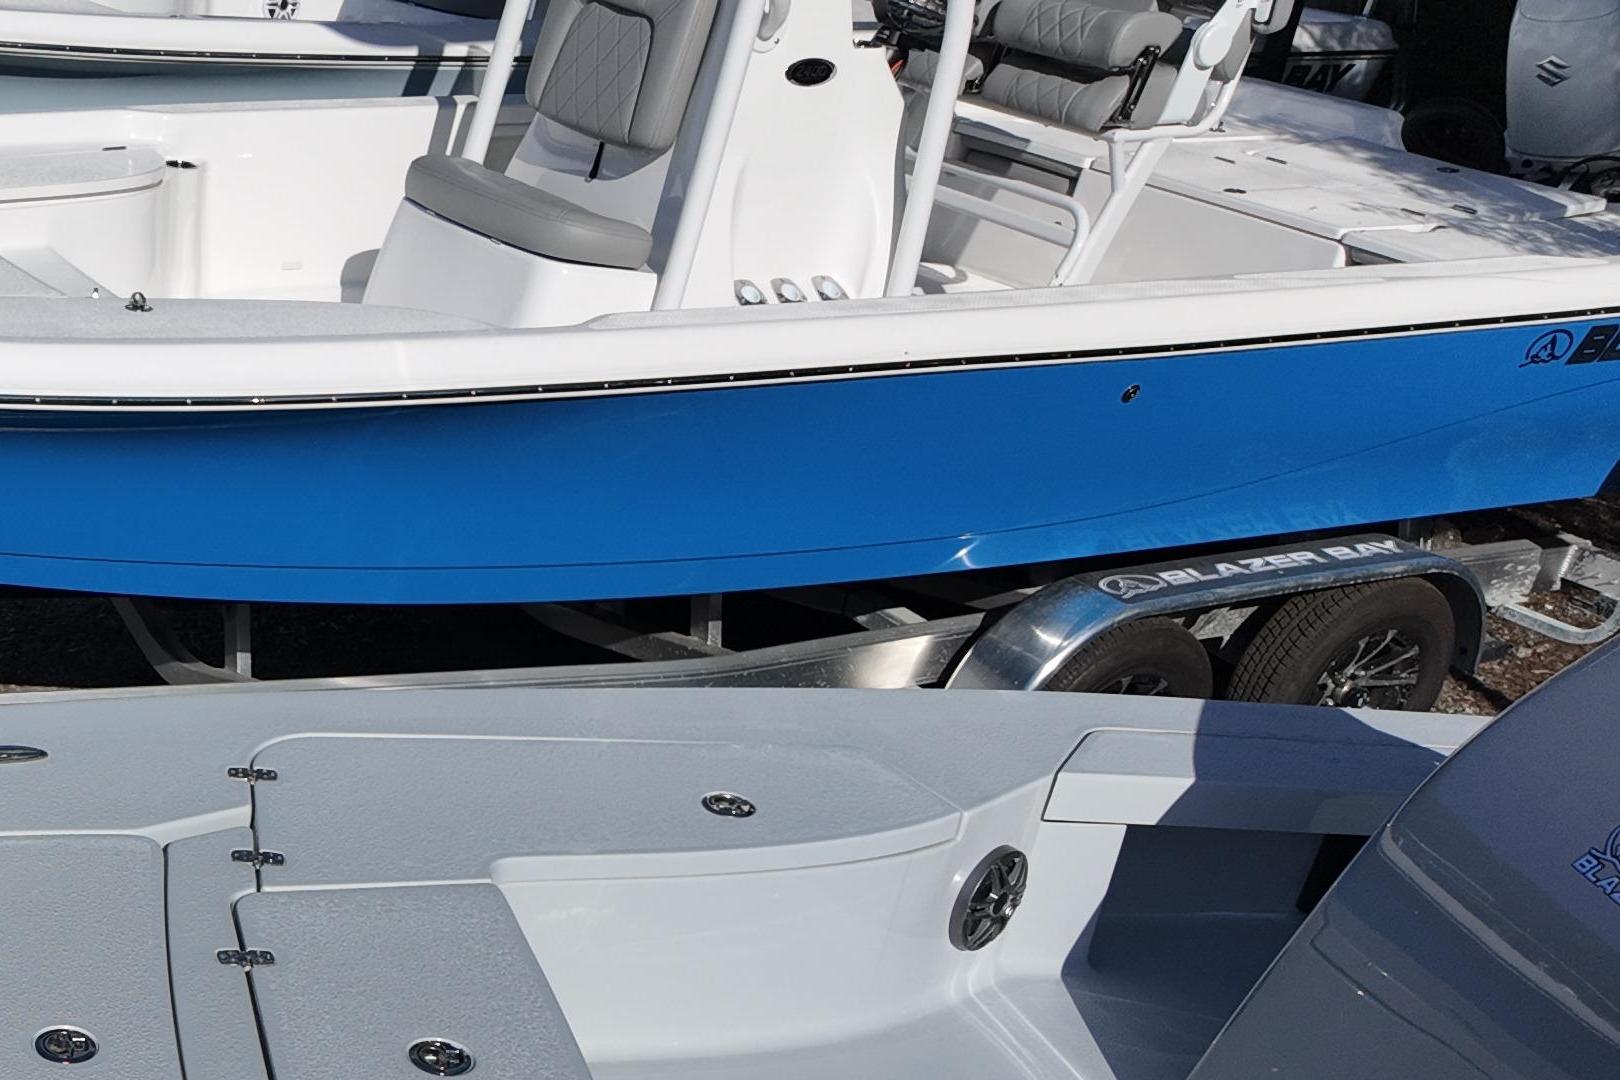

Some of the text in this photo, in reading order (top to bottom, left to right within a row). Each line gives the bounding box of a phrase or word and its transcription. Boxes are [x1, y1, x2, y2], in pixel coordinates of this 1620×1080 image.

[1283, 63, 1356, 94] BAY
[1157, 540, 1404, 587] BLAZER BAY
